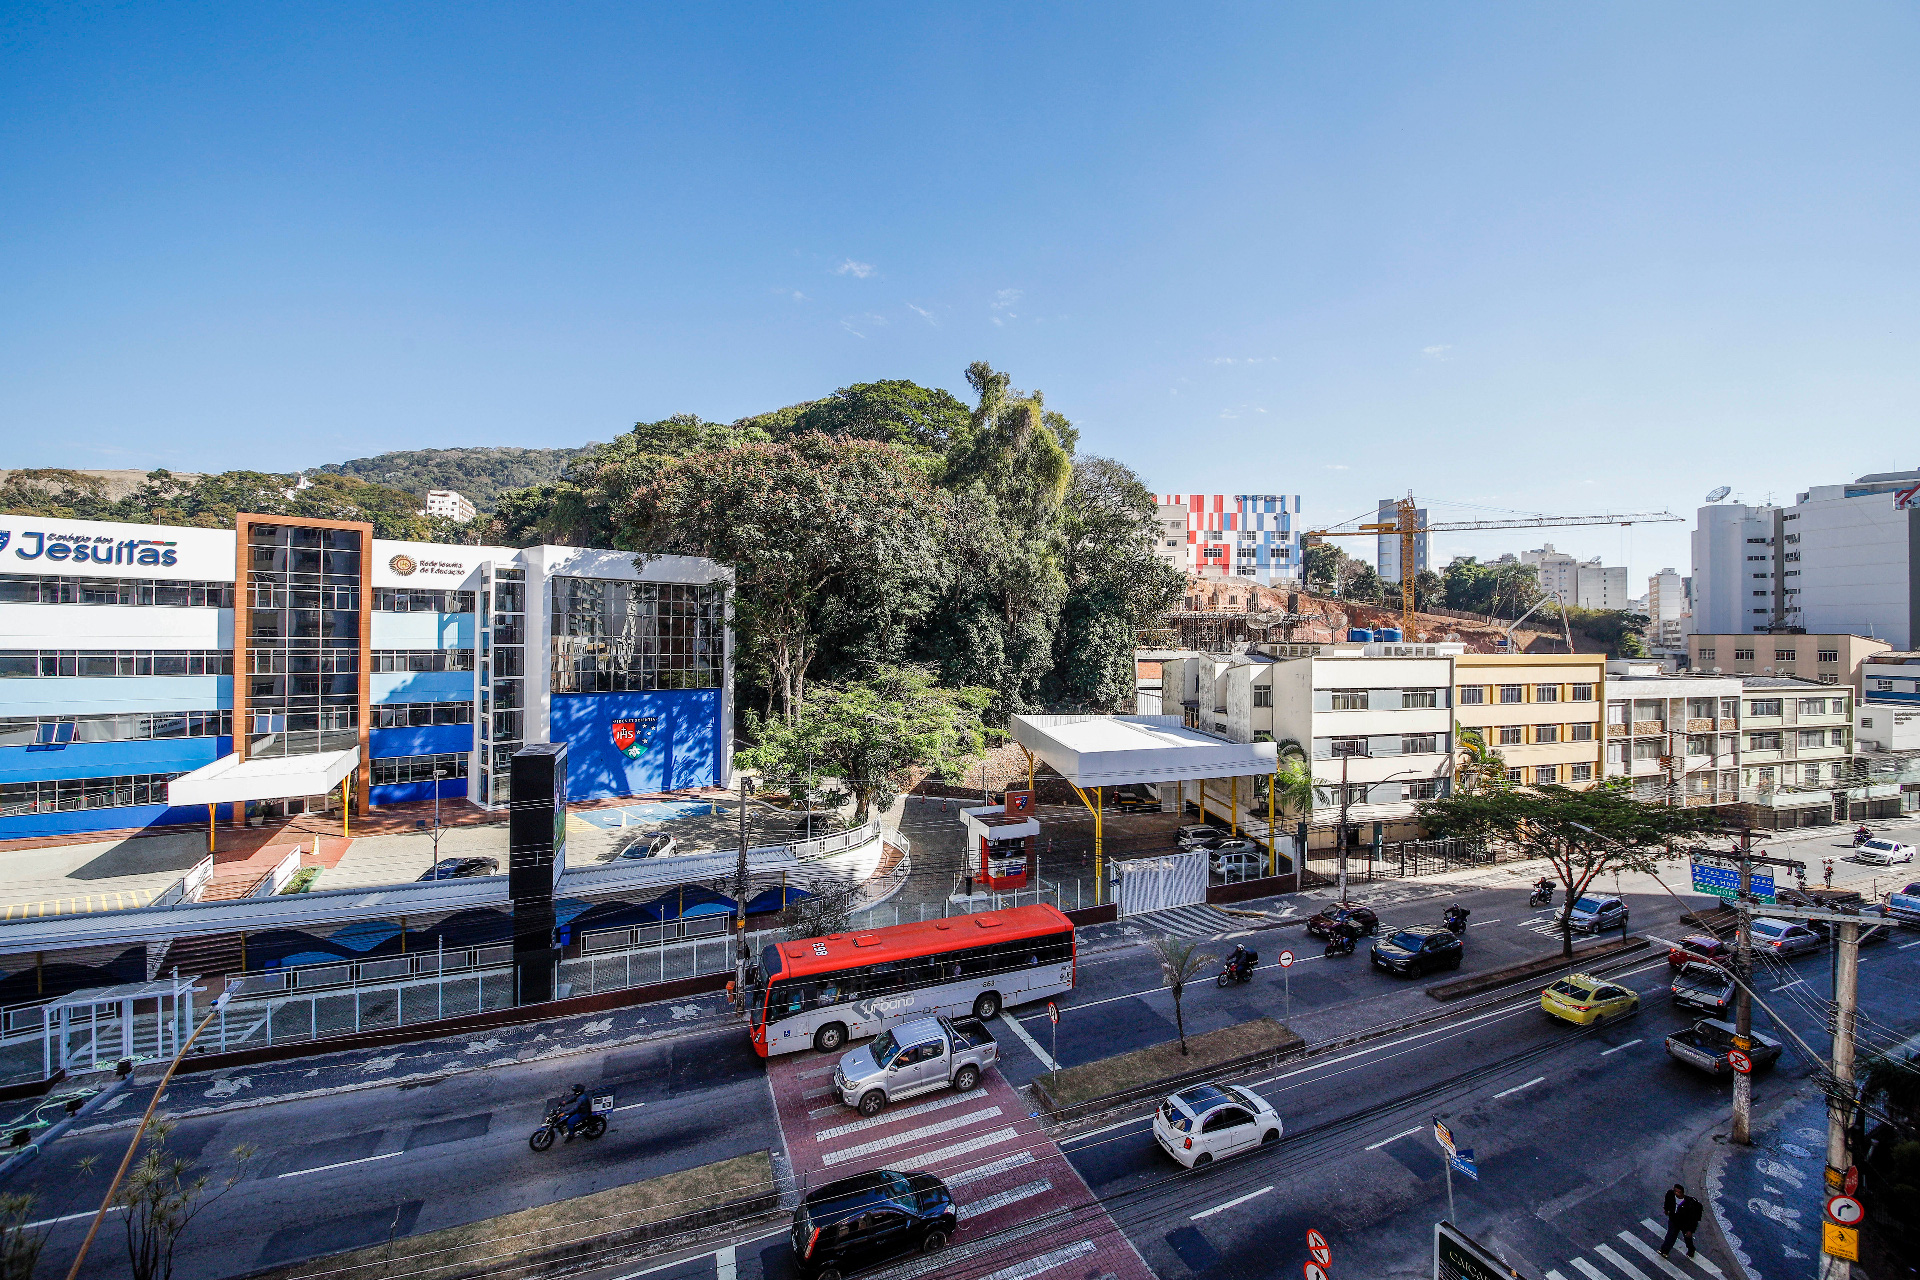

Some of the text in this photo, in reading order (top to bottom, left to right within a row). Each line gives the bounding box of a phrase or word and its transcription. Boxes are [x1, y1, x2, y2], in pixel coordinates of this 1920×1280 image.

[47, 532, 114, 544] Colégio dos
[15, 531, 178, 567] Jesuítas
[616, 726, 634, 740] IHS
[1703, 858, 1732, 868] Centro
[812, 942, 828, 956] 863
[864, 997, 915, 1015] urbano
